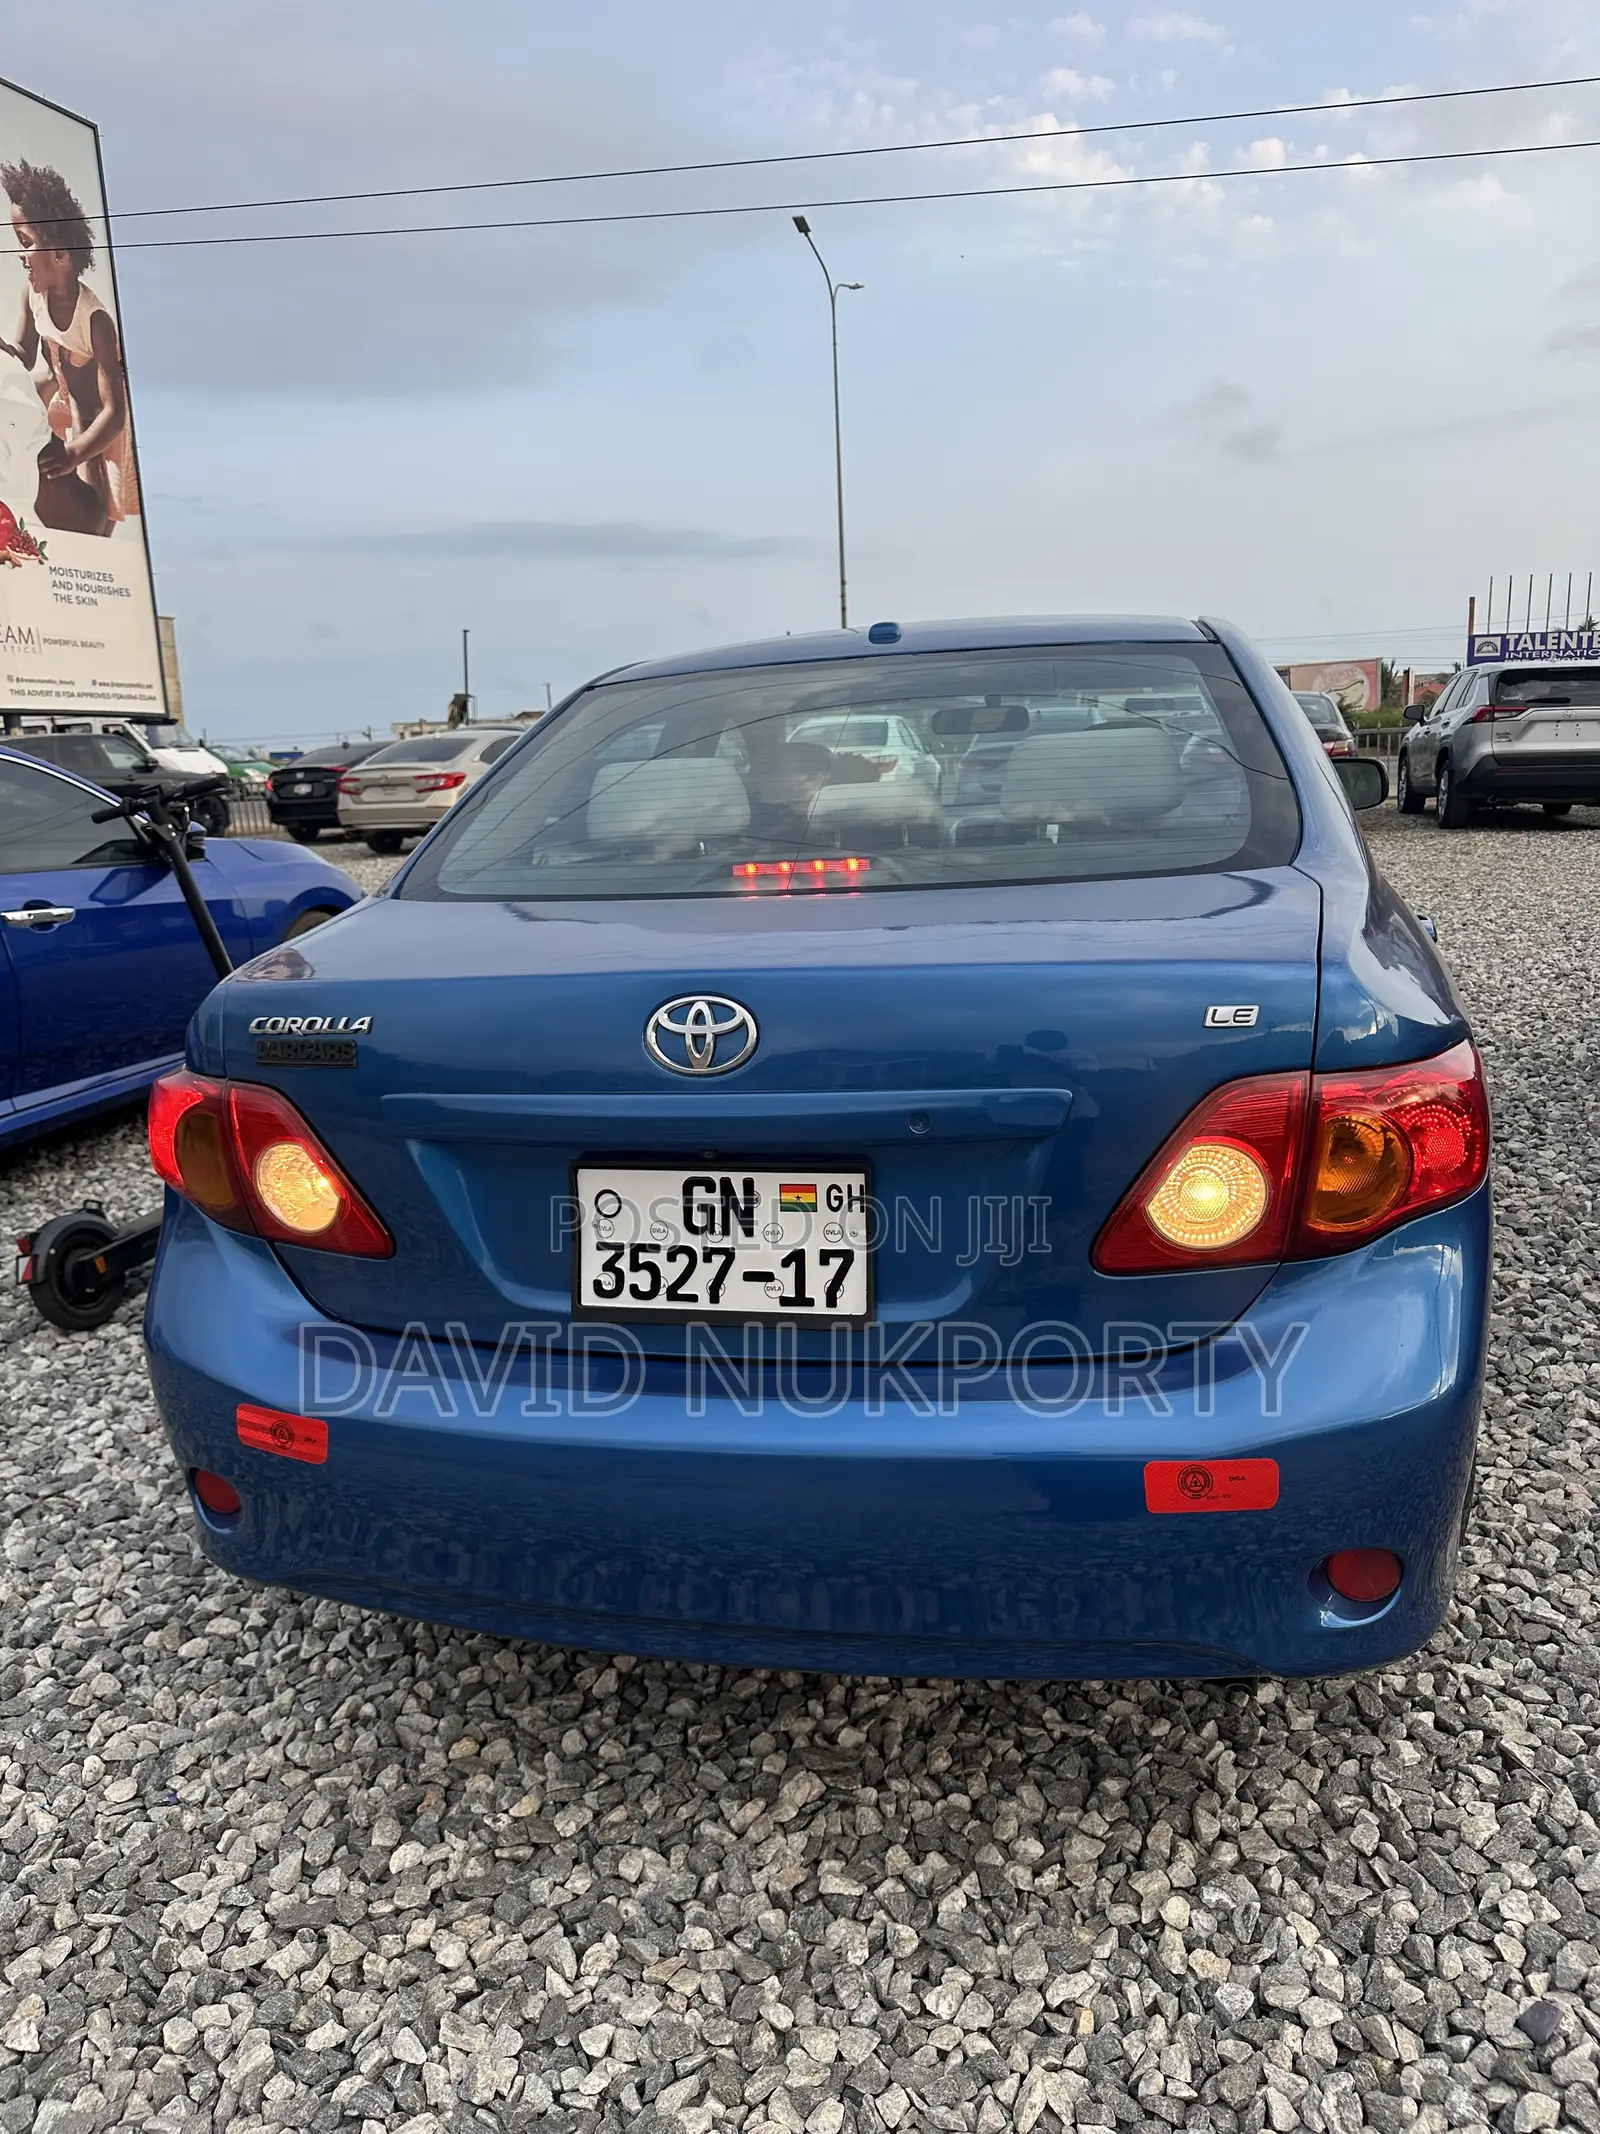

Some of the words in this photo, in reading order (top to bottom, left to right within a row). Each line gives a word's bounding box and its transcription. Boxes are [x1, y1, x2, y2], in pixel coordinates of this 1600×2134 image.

[49, 566, 114, 582] MOISTURIZES
[52, 580, 73, 590] AND
[76, 583, 131, 597] NOURISHES
[53, 593, 73, 604] THE
[75, 595, 98, 606] SKIN
[43, 637, 79, 648] POWERFUL
[80, 641, 105, 649] BEAUTY
[1506, 631, 1600, 651] TALENTE
[9, 688, 26, 696] THIS
[27, 689, 53, 697] ADVERT
[1211, 1008, 1254, 1023] LE
[249, 1016, 373, 1036] COROLLA
[682, 1176, 755, 1237] GN
[826, 1184, 865, 1213] GH
[592, 1241, 855, 1309] 3527-17
